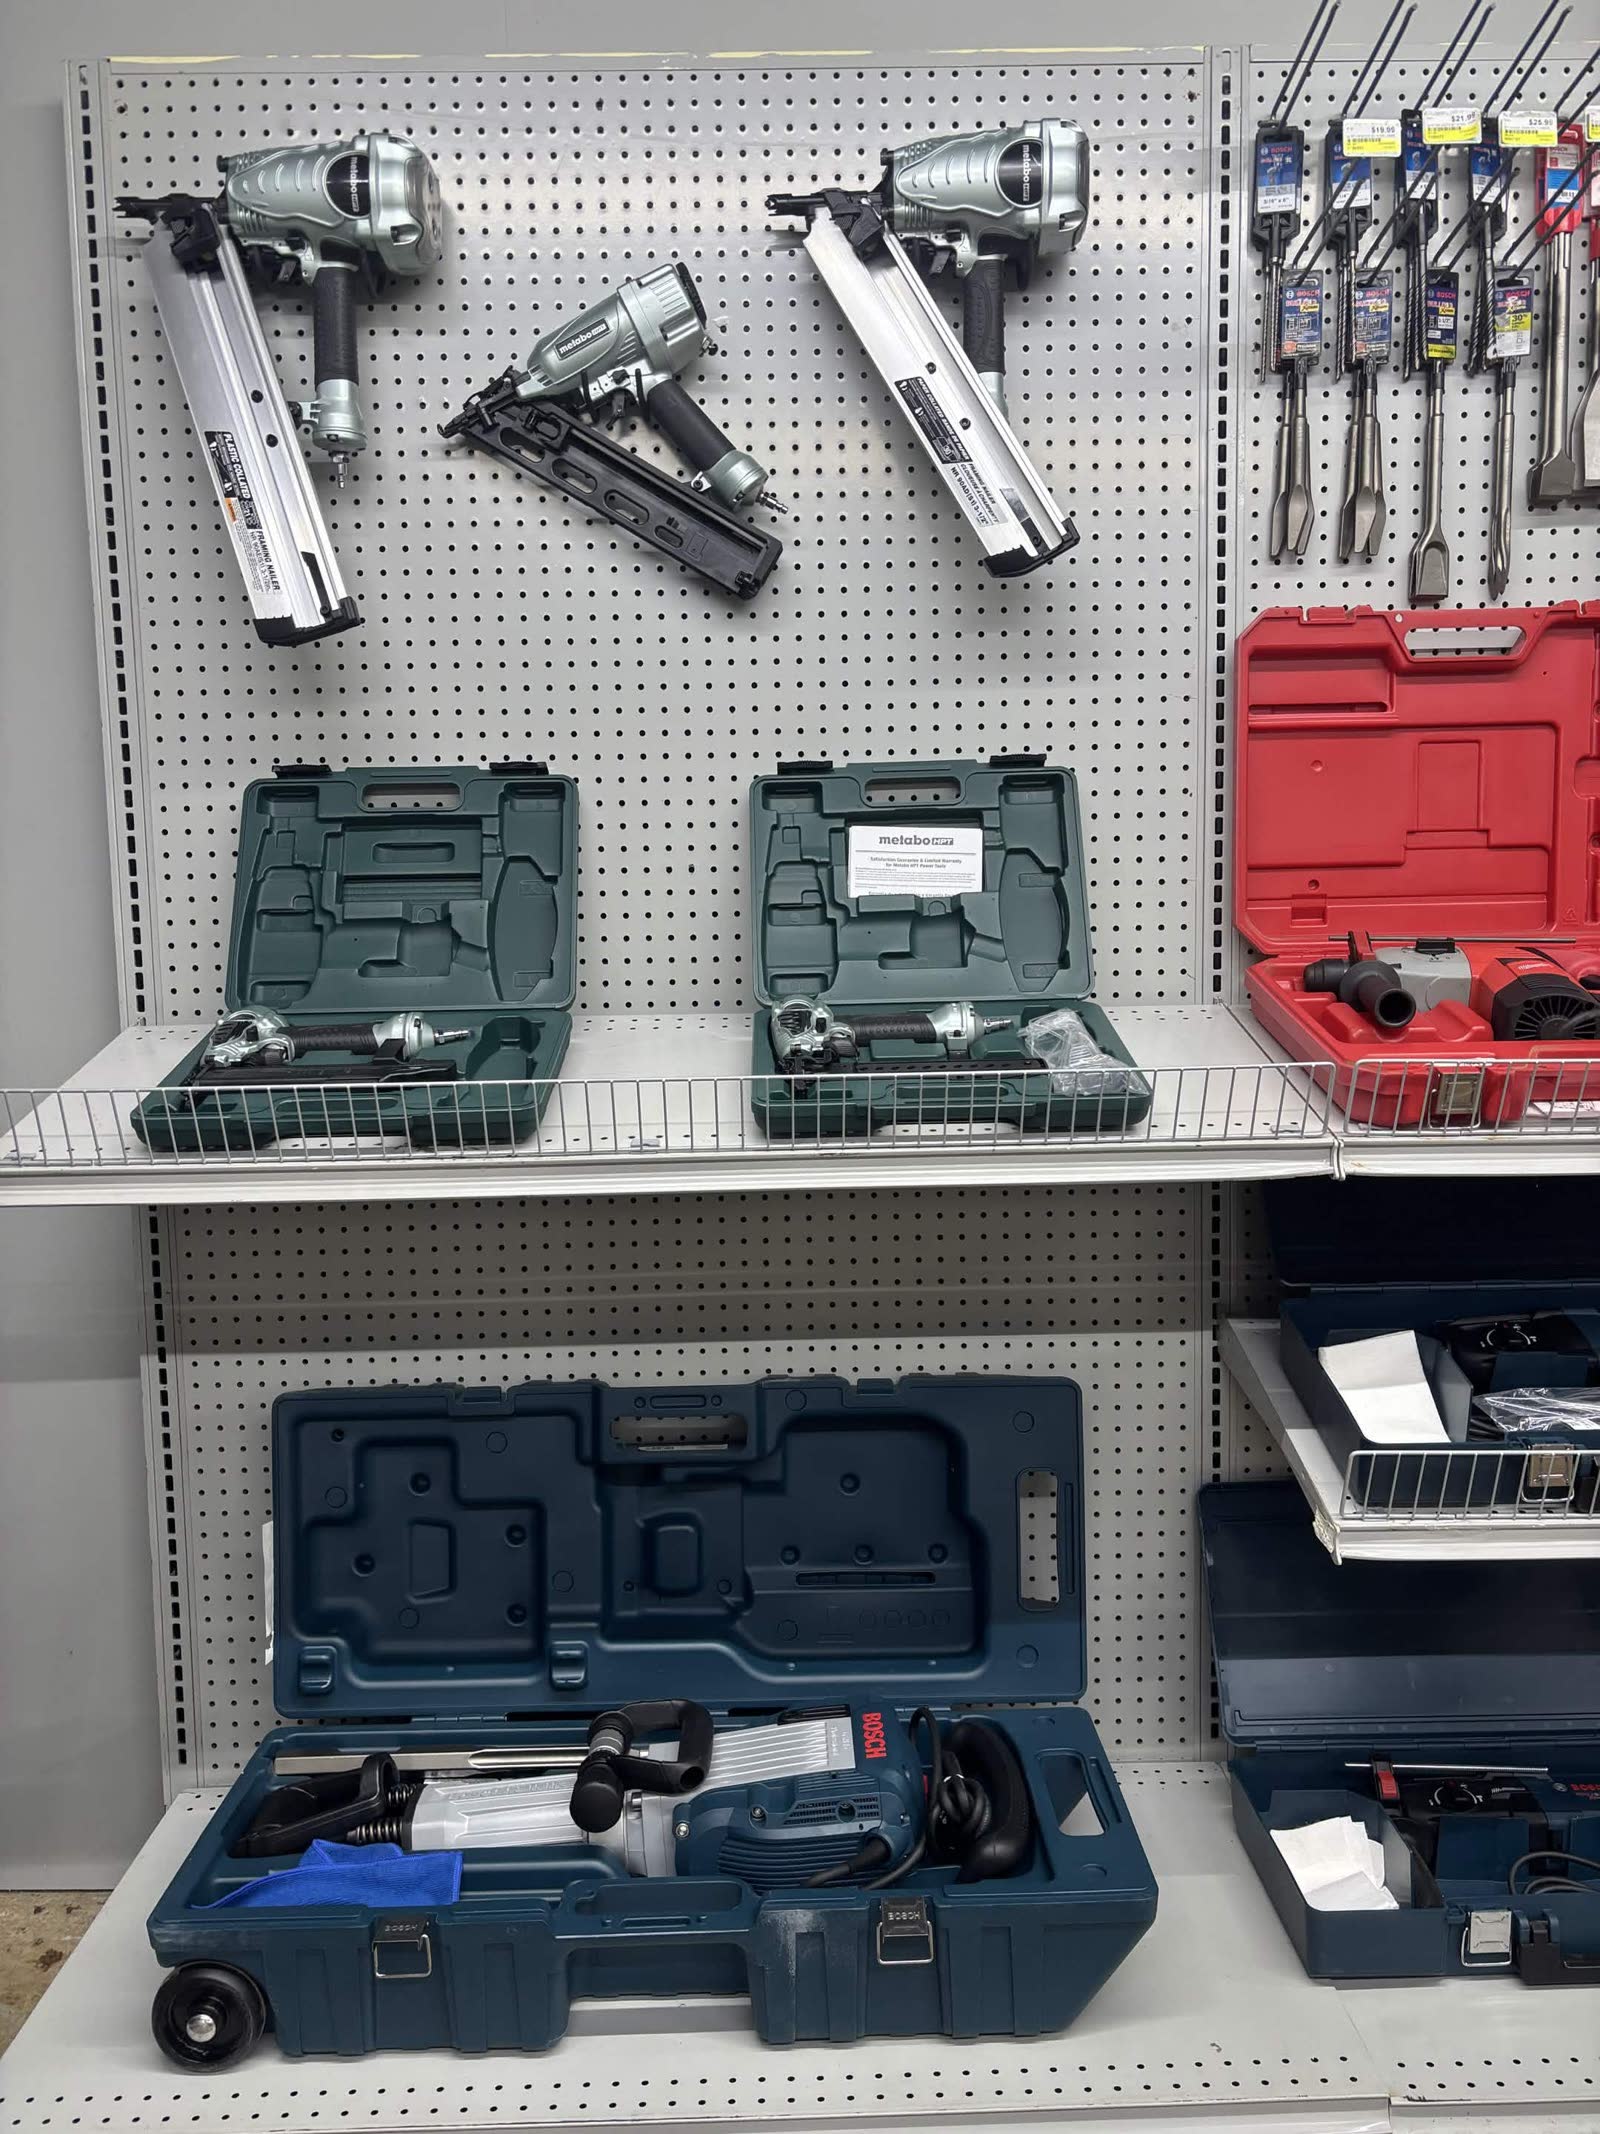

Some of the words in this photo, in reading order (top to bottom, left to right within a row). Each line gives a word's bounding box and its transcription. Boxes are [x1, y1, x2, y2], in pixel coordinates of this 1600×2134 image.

[1296, 289, 1321, 297] BOSCH
[1365, 289, 1390, 298] BOSCH
[558, 331, 593, 354] metabo
[224, 433, 239, 463] PLASTIC
[234, 463, 250, 499] COLLATED
[256, 530, 272, 563] FRAMING
[267, 565, 280, 591] NAILER
[878, 835, 931, 846] metabo
[862, 1712, 887, 1759] BOSCH
[888, 1911, 921, 1921] BOSCH
